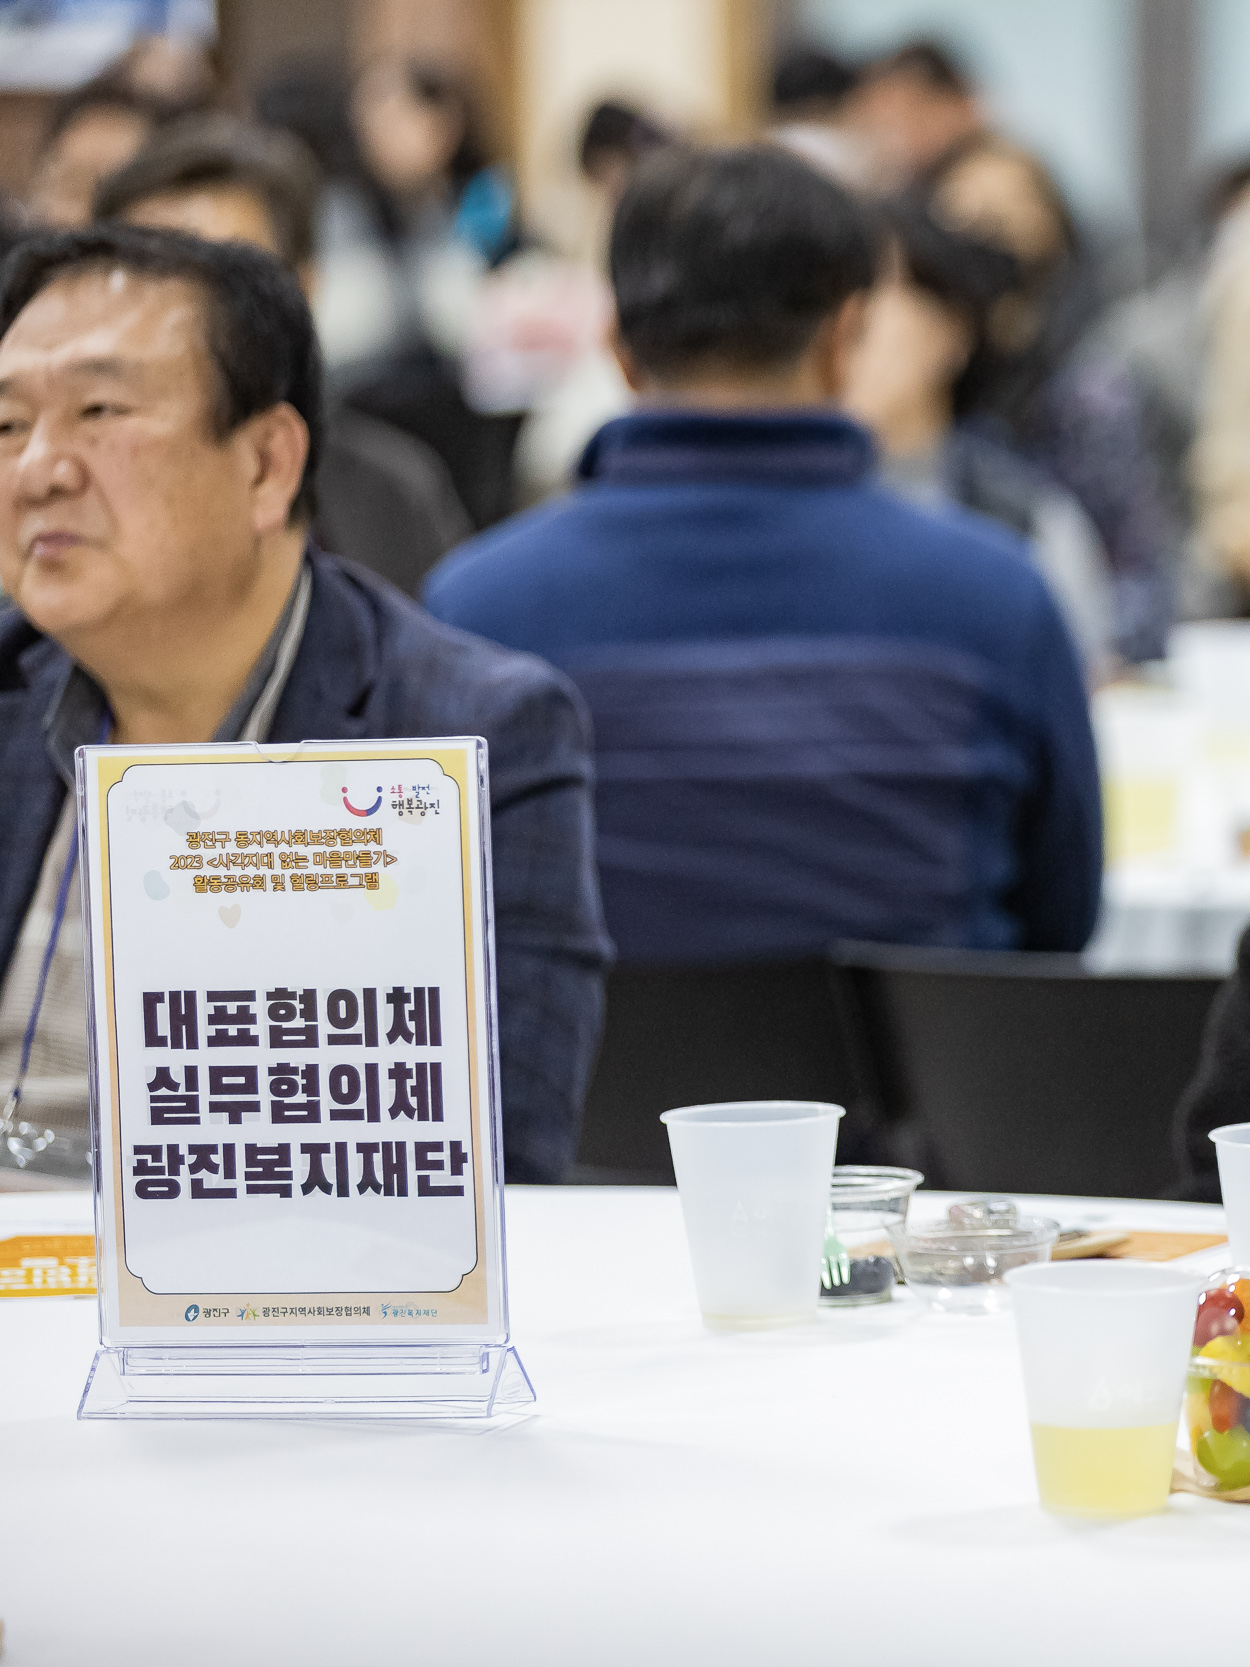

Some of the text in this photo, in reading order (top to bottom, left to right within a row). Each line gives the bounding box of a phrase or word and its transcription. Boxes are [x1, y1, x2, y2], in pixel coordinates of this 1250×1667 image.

[390, 784, 430, 798] 소통 발전
[391, 798, 440, 816] 행복광진
[186, 828, 383, 849] 광진구 동지역사회보장협의체
[169, 850, 398, 870] 2023 <사각지대 없는 마을만들기>
[193, 872, 380, 893] 활동공유회 및 힐링프로그램
[142, 986, 442, 1050] 대표협의체
[146, 1062, 444, 1126] 실무협의체
[132, 1140, 469, 1200] 광진복지재단
[203, 1307, 230, 1318] 광진구
[262, 1306, 371, 1318] 광진구지역사회보장협의체
